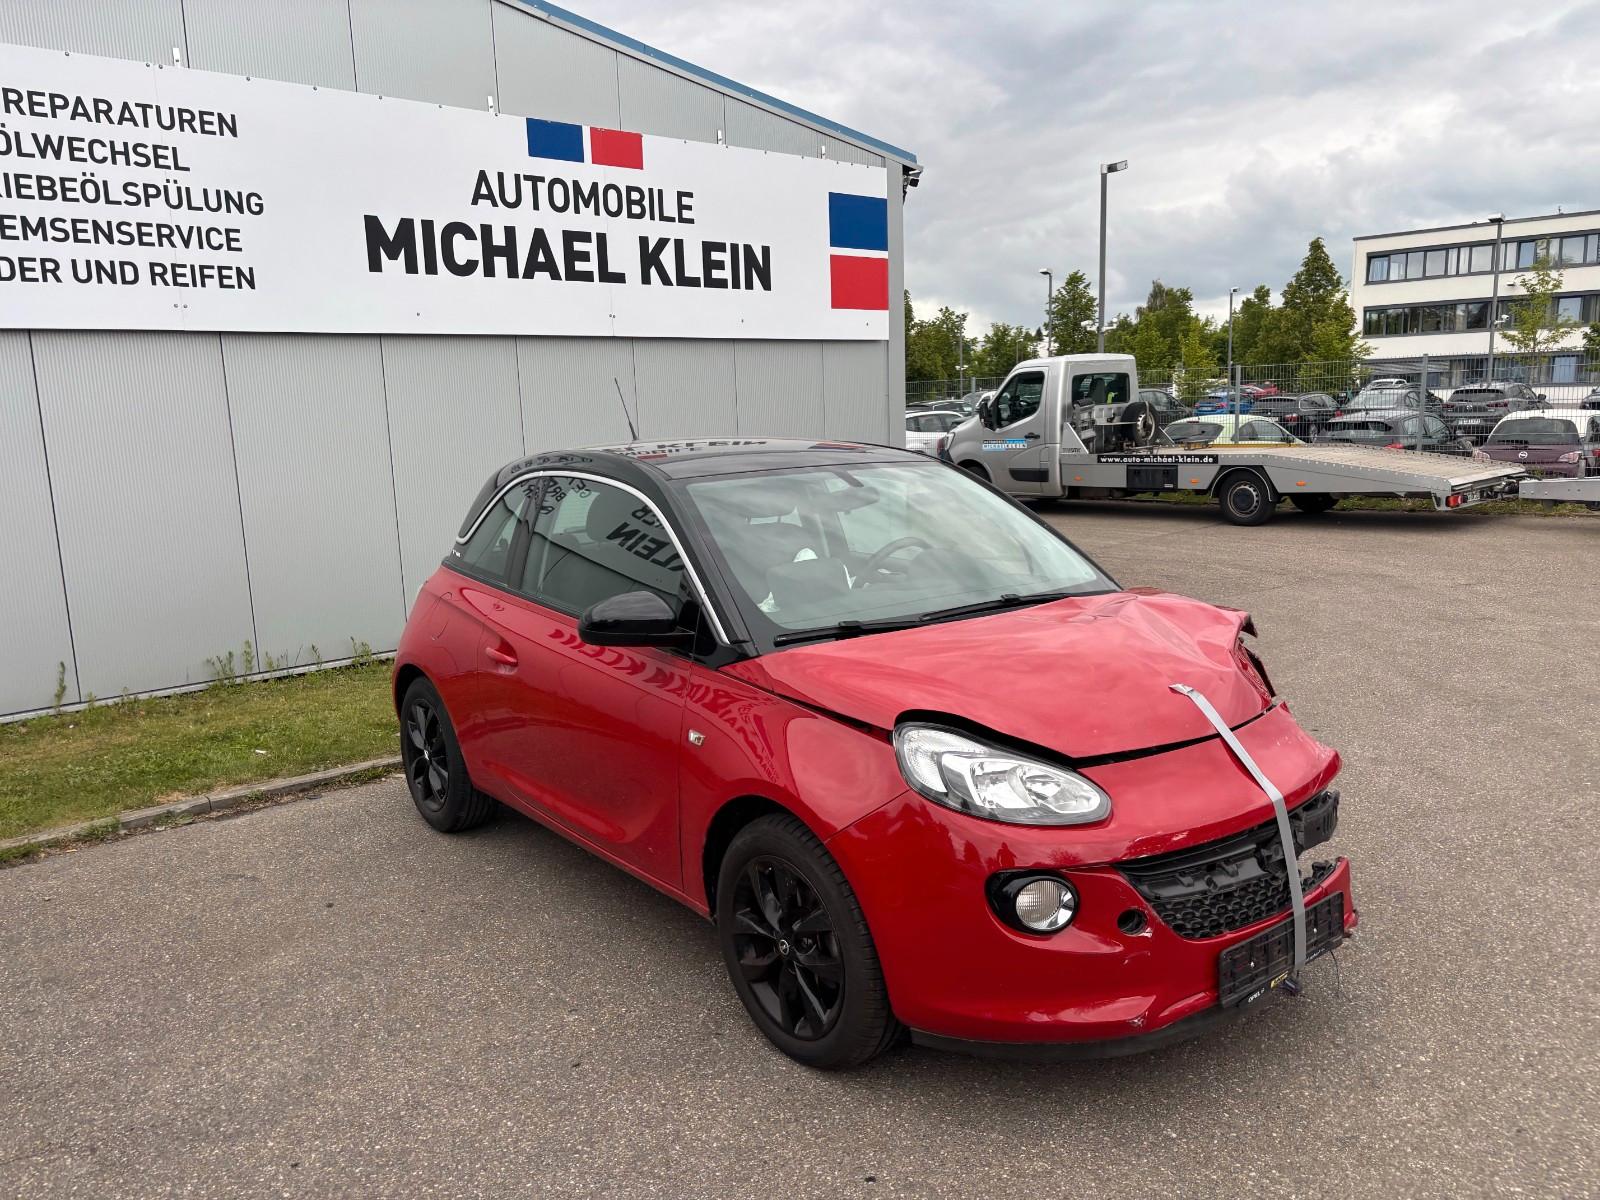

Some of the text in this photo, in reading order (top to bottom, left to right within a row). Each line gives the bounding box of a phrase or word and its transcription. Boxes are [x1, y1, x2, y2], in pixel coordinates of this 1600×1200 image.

[2, 87, 238, 138] REPARATUREN
[0, 171, 264, 216] IEBEÖLSPÜLUNG
[471, 169, 695, 225] AUTOMOBILE
[0, 214, 243, 252] EMSENSERVICE
[363, 214, 772, 292] MICHAEL KLEIN
[71, 258, 140, 285] UND
[149, 261, 256, 290] REIFEN
[1100, 455, 1213, 463] www.auto-michael-klein.de
